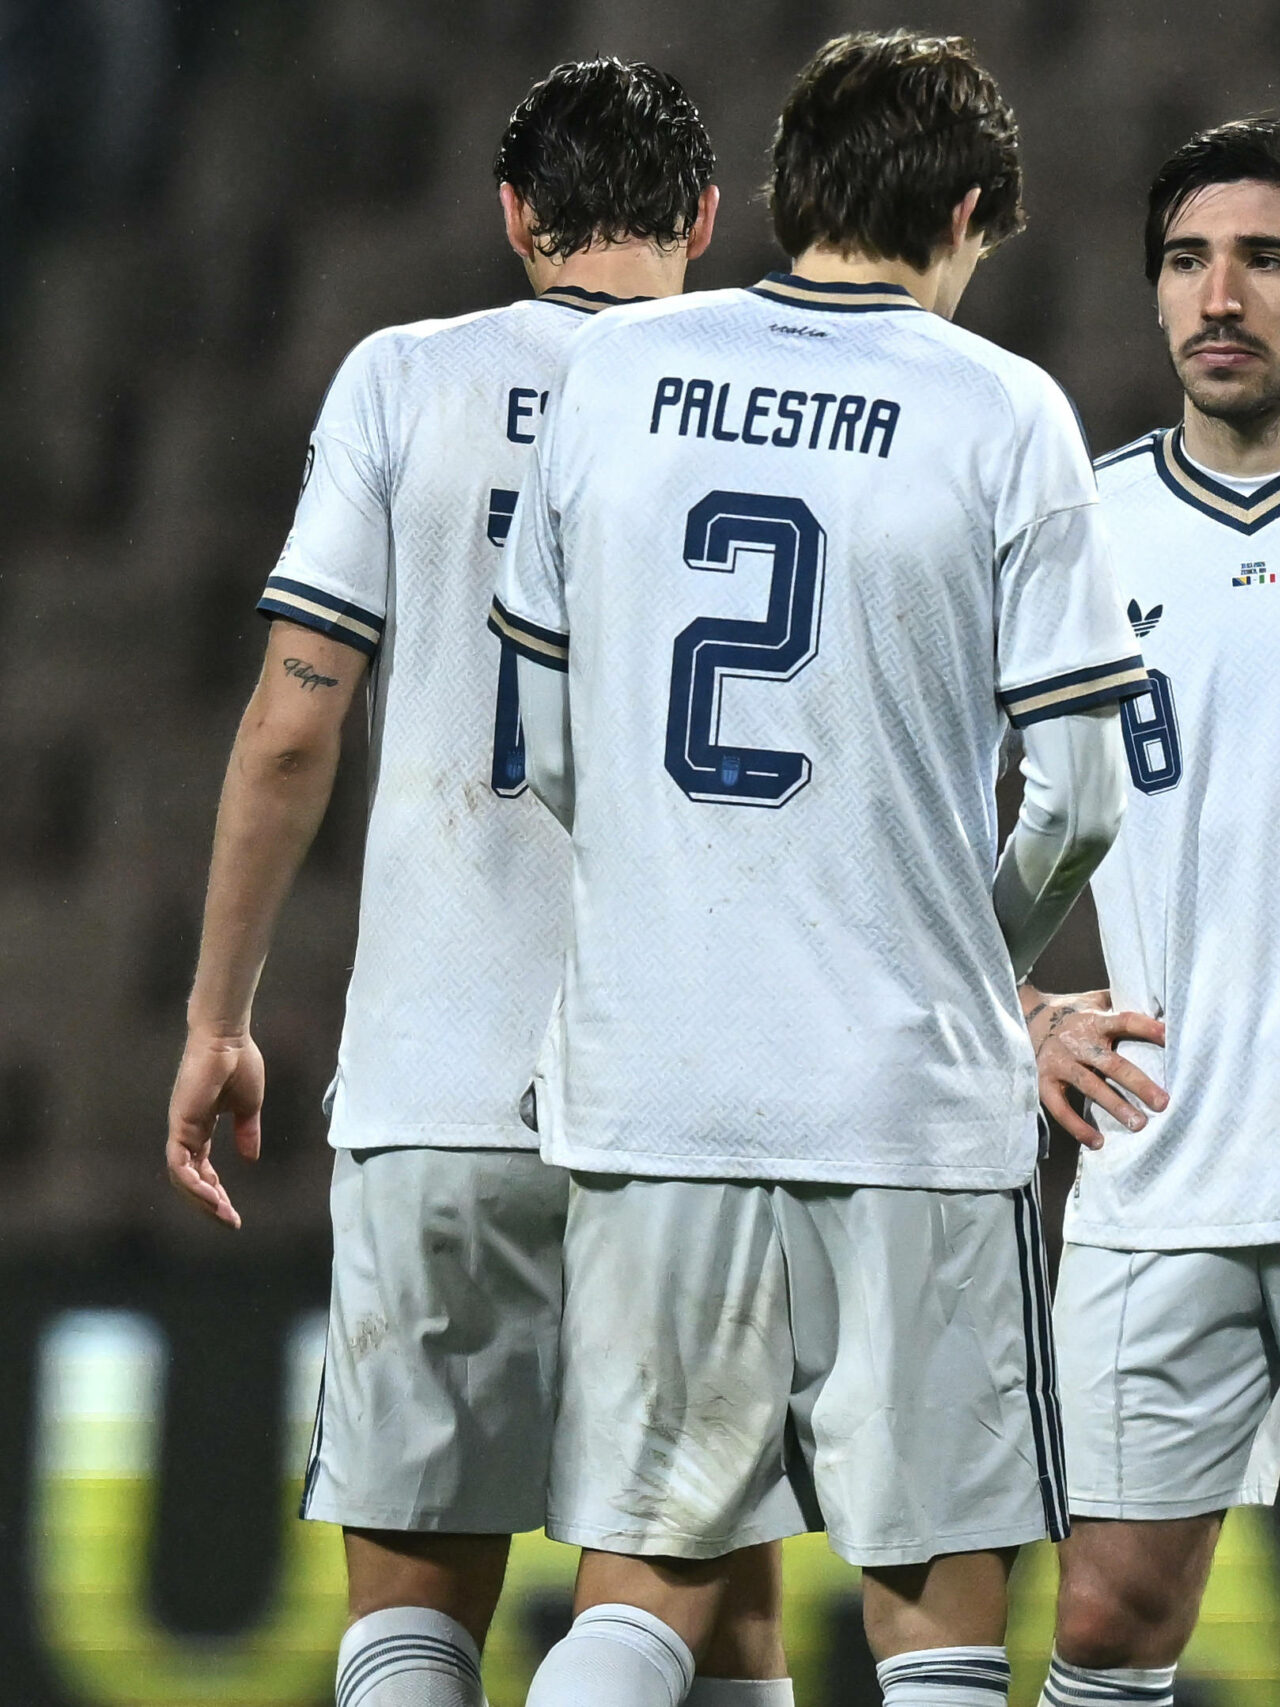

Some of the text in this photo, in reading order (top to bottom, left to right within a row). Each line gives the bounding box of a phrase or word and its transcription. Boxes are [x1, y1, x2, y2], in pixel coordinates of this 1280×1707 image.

[649, 377, 901, 459] PALESTRA
[663, 490, 828, 809] 2
[1119, 668, 1183, 796] 8
